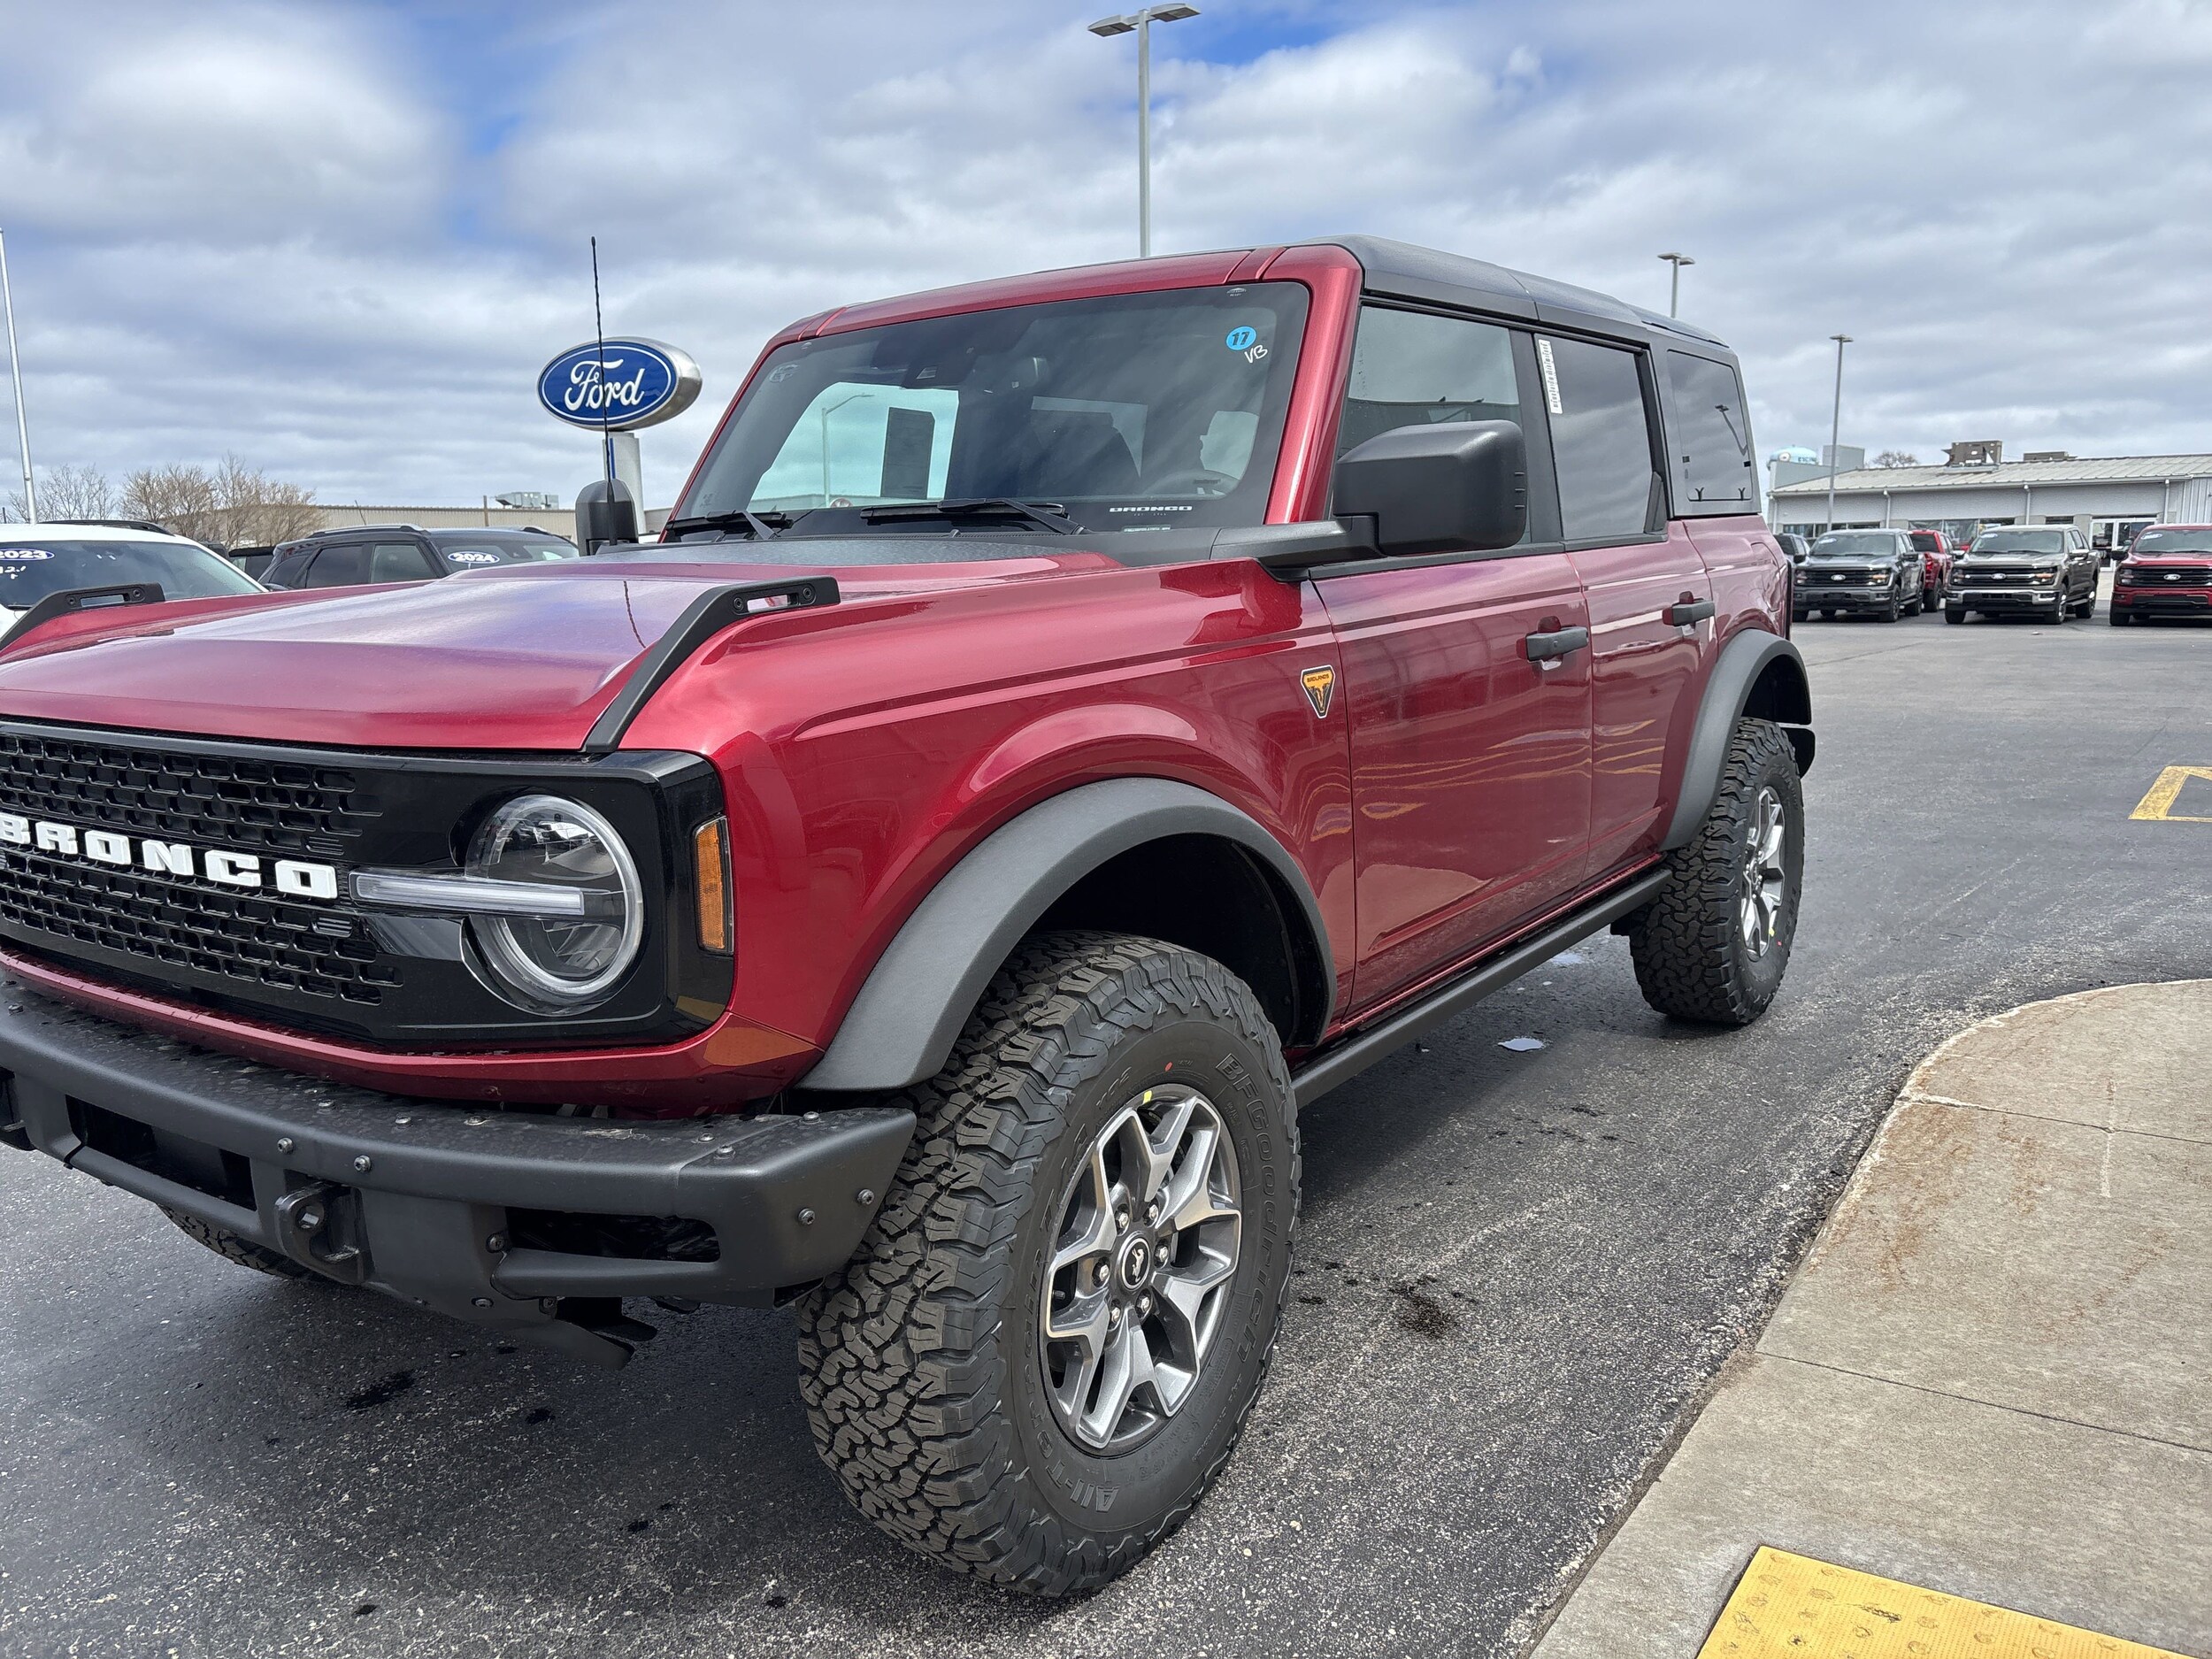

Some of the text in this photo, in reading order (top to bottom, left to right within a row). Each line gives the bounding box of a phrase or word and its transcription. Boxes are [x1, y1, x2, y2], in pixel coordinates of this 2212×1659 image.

[1232, 331, 1250, 346] 17
[1244, 344, 1268, 364] VB
[565, 358, 645, 411] Ford
[452, 551, 495, 564] 2024
[0, 812, 338, 899] BRONCO
[1216, 1053, 1278, 1363] BFGoodrich
